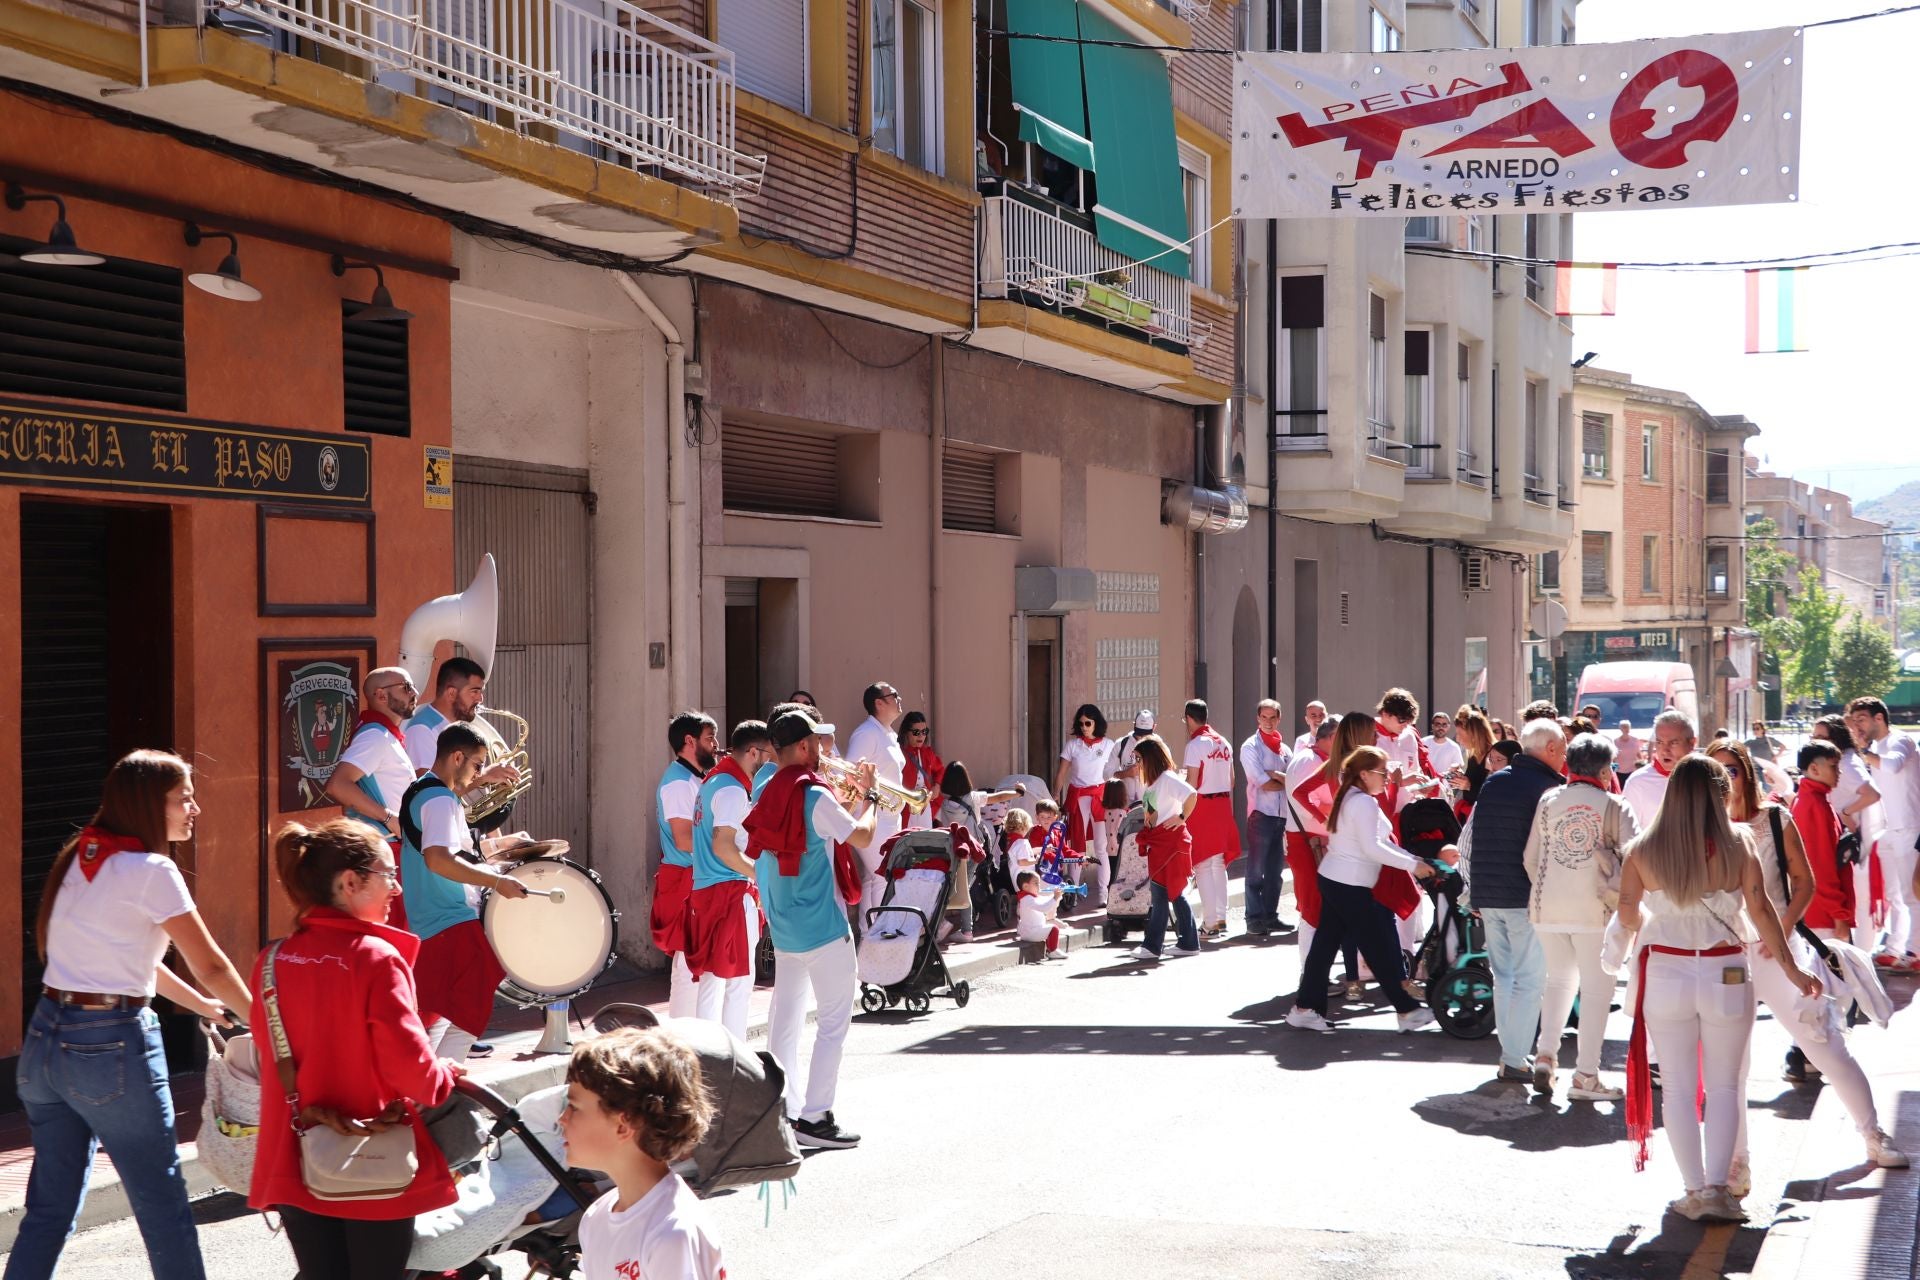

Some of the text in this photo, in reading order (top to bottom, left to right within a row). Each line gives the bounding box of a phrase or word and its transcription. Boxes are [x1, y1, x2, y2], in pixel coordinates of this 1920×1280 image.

[1322, 77, 1483, 122] PEÑA
[1446, 157, 1560, 179] ARNEDO
[1331, 180, 1690, 211] Felices Fiestas
[150, 430, 190, 474] EL
[214, 436, 292, 488] PASO
